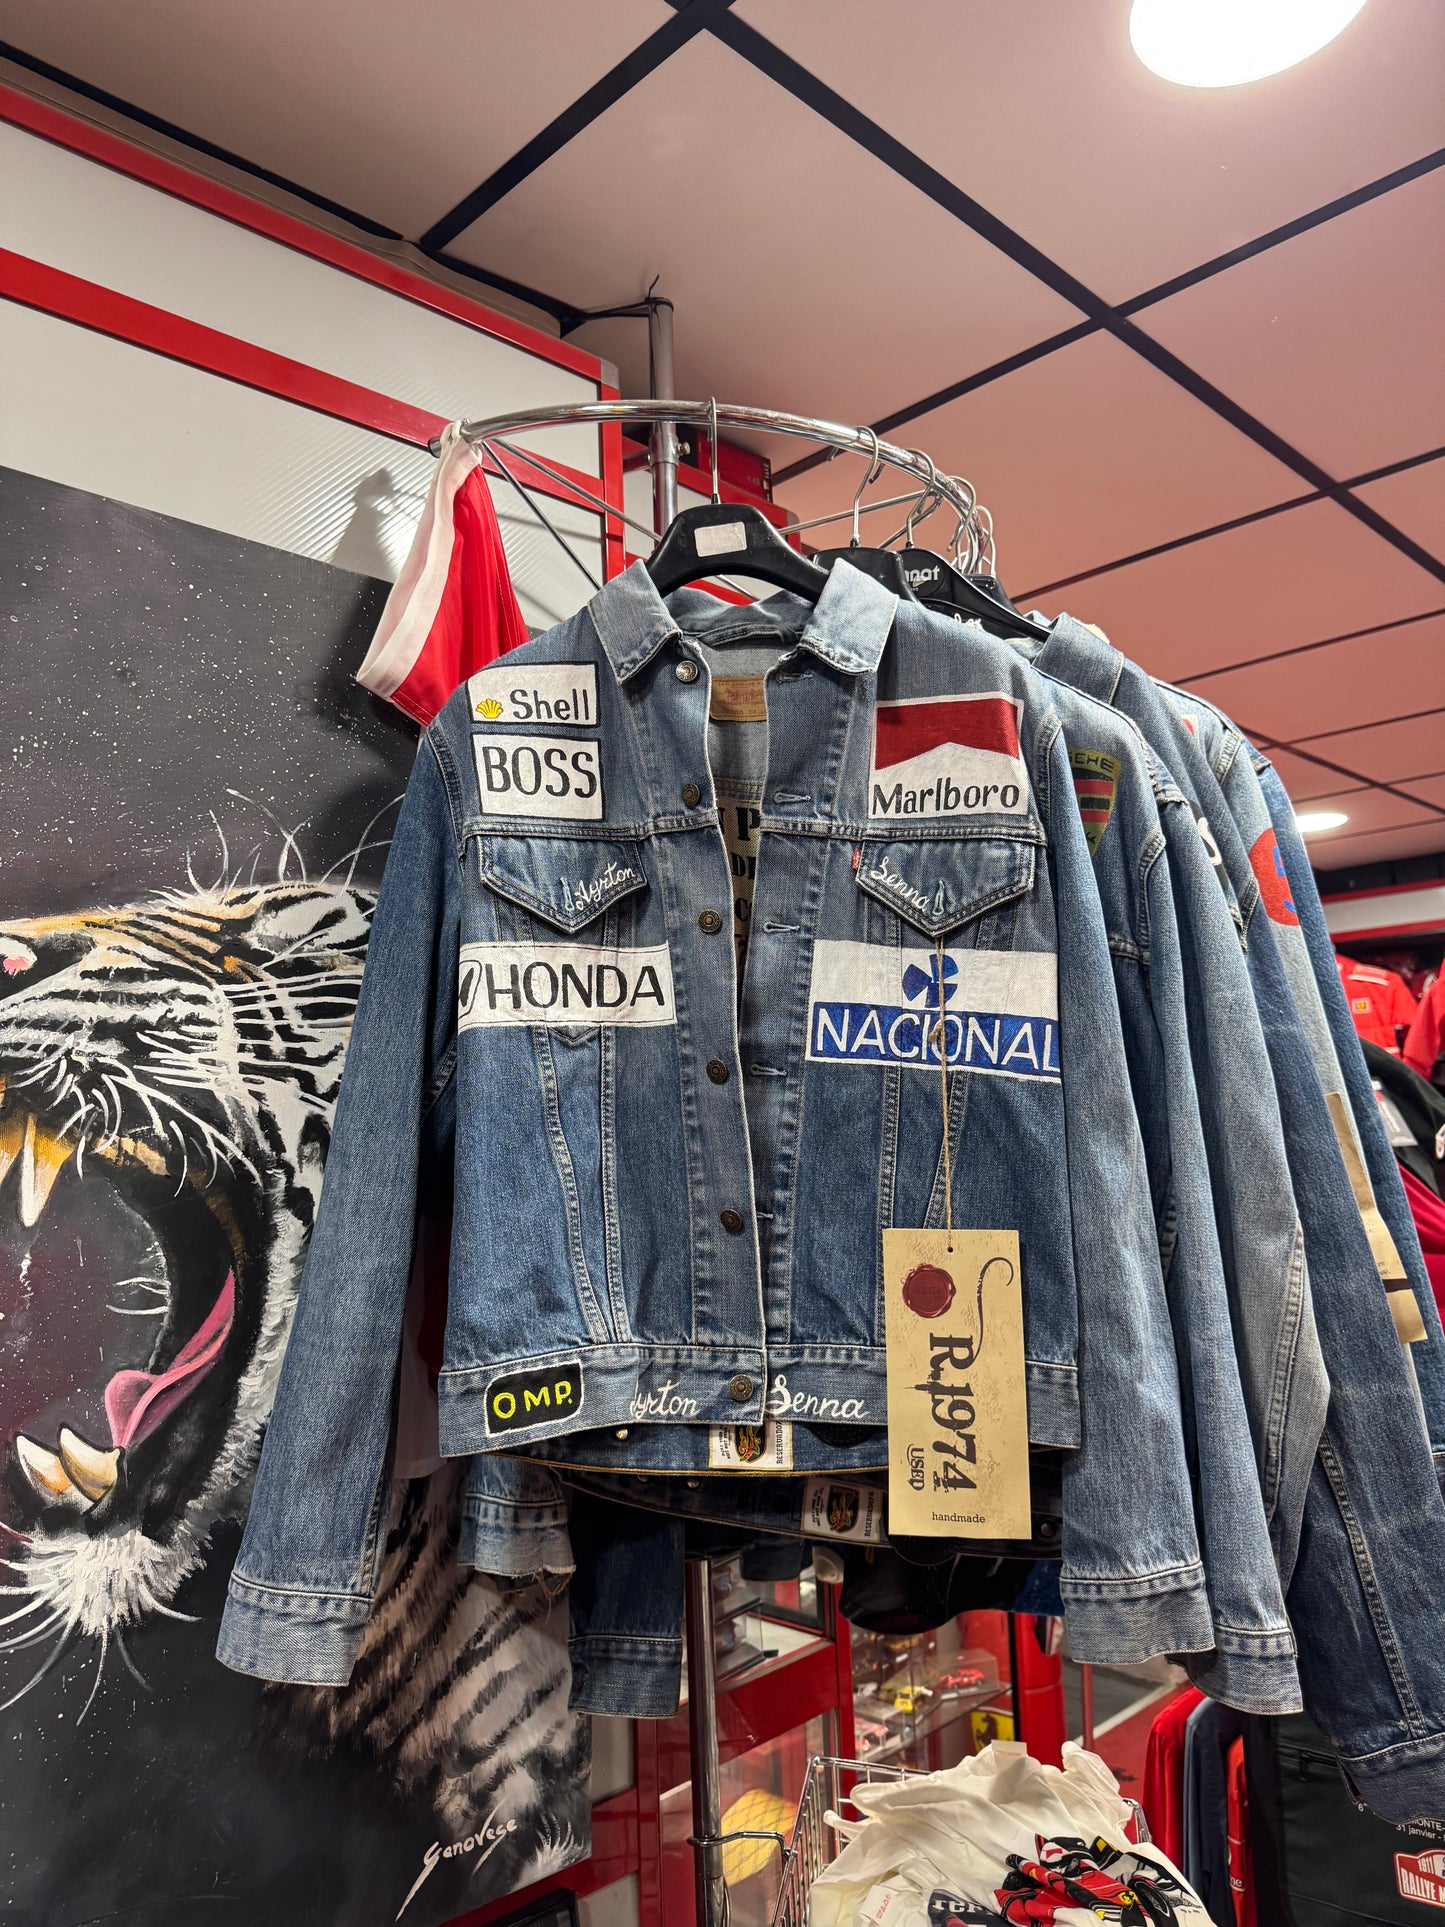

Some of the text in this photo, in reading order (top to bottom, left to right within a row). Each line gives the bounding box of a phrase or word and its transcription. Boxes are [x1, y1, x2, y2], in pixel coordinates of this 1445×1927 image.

[509, 688, 590, 721] Shell
[481, 746, 597, 799] BOSS
[872, 777, 1020, 816] Marlboro
[574, 861, 635, 911] Ayrton
[870, 856, 930, 913] Senna
[485, 961, 665, 1010] HONDA
[816, 1008, 1060, 1072] NACIONAL
[764, 1374, 869, 1418] Senna
[908, 1444, 925, 1490] USED
[931, 1511, 986, 1523] handmade
[1408, 1825, 1436, 1839] janvier
[1400, 1867, 1437, 1901] RALLYE
[1418, 1855, 1435, 1875] 1911
